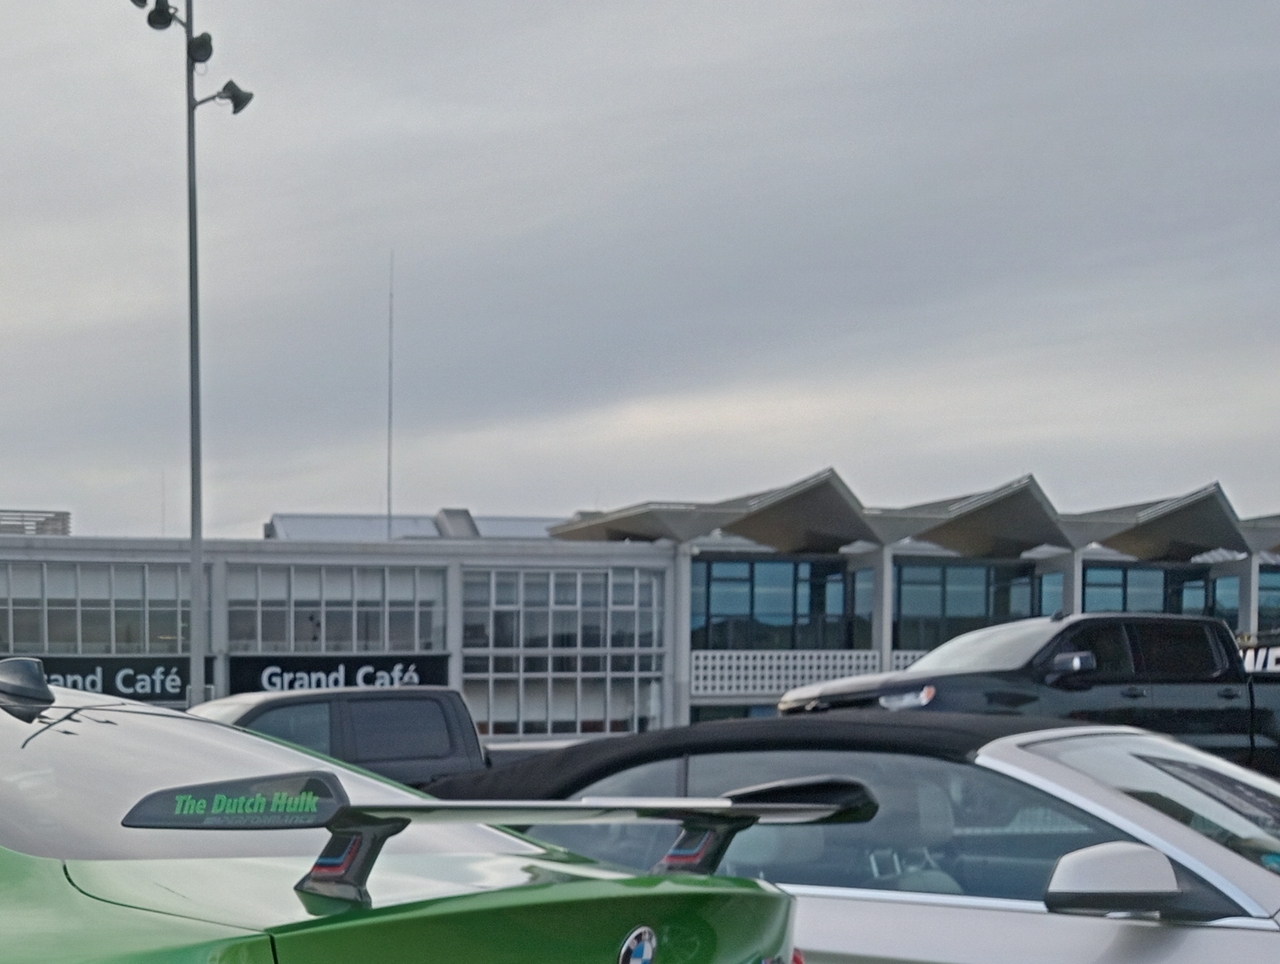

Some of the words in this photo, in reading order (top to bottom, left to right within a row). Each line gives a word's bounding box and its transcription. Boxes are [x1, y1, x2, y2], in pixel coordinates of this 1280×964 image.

[115, 667, 182, 694] Café
[260, 663, 346, 691] Grand
[355, 663, 420, 688] Café
[175, 794, 207, 815] The
[211, 793, 266, 814] Dutch
[270, 791, 320, 813] Hulk
